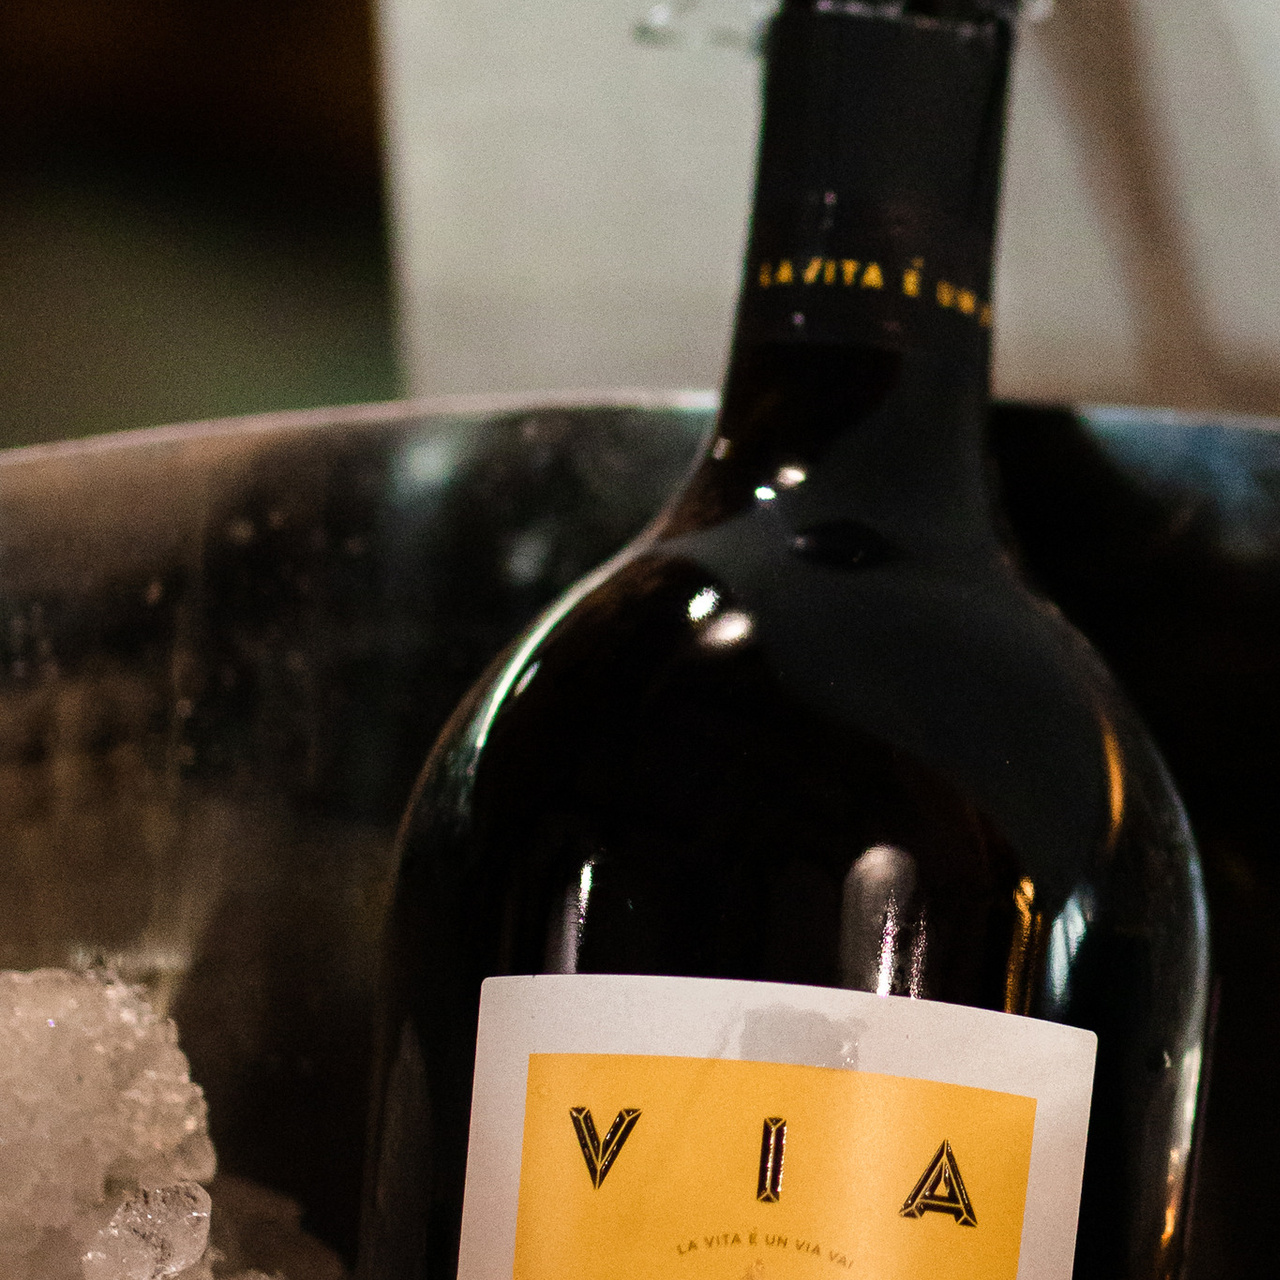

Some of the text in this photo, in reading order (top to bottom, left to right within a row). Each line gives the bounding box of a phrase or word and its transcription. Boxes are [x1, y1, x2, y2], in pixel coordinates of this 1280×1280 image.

[568, 1106, 978, 1228] VIA
[677, 1240, 698, 1256] LA
[704, 1232, 742, 1249] VITA
[765, 1233, 788, 1249] UN
[796, 1239, 821, 1256] VIA
[829, 1250, 854, 1269] VAI
